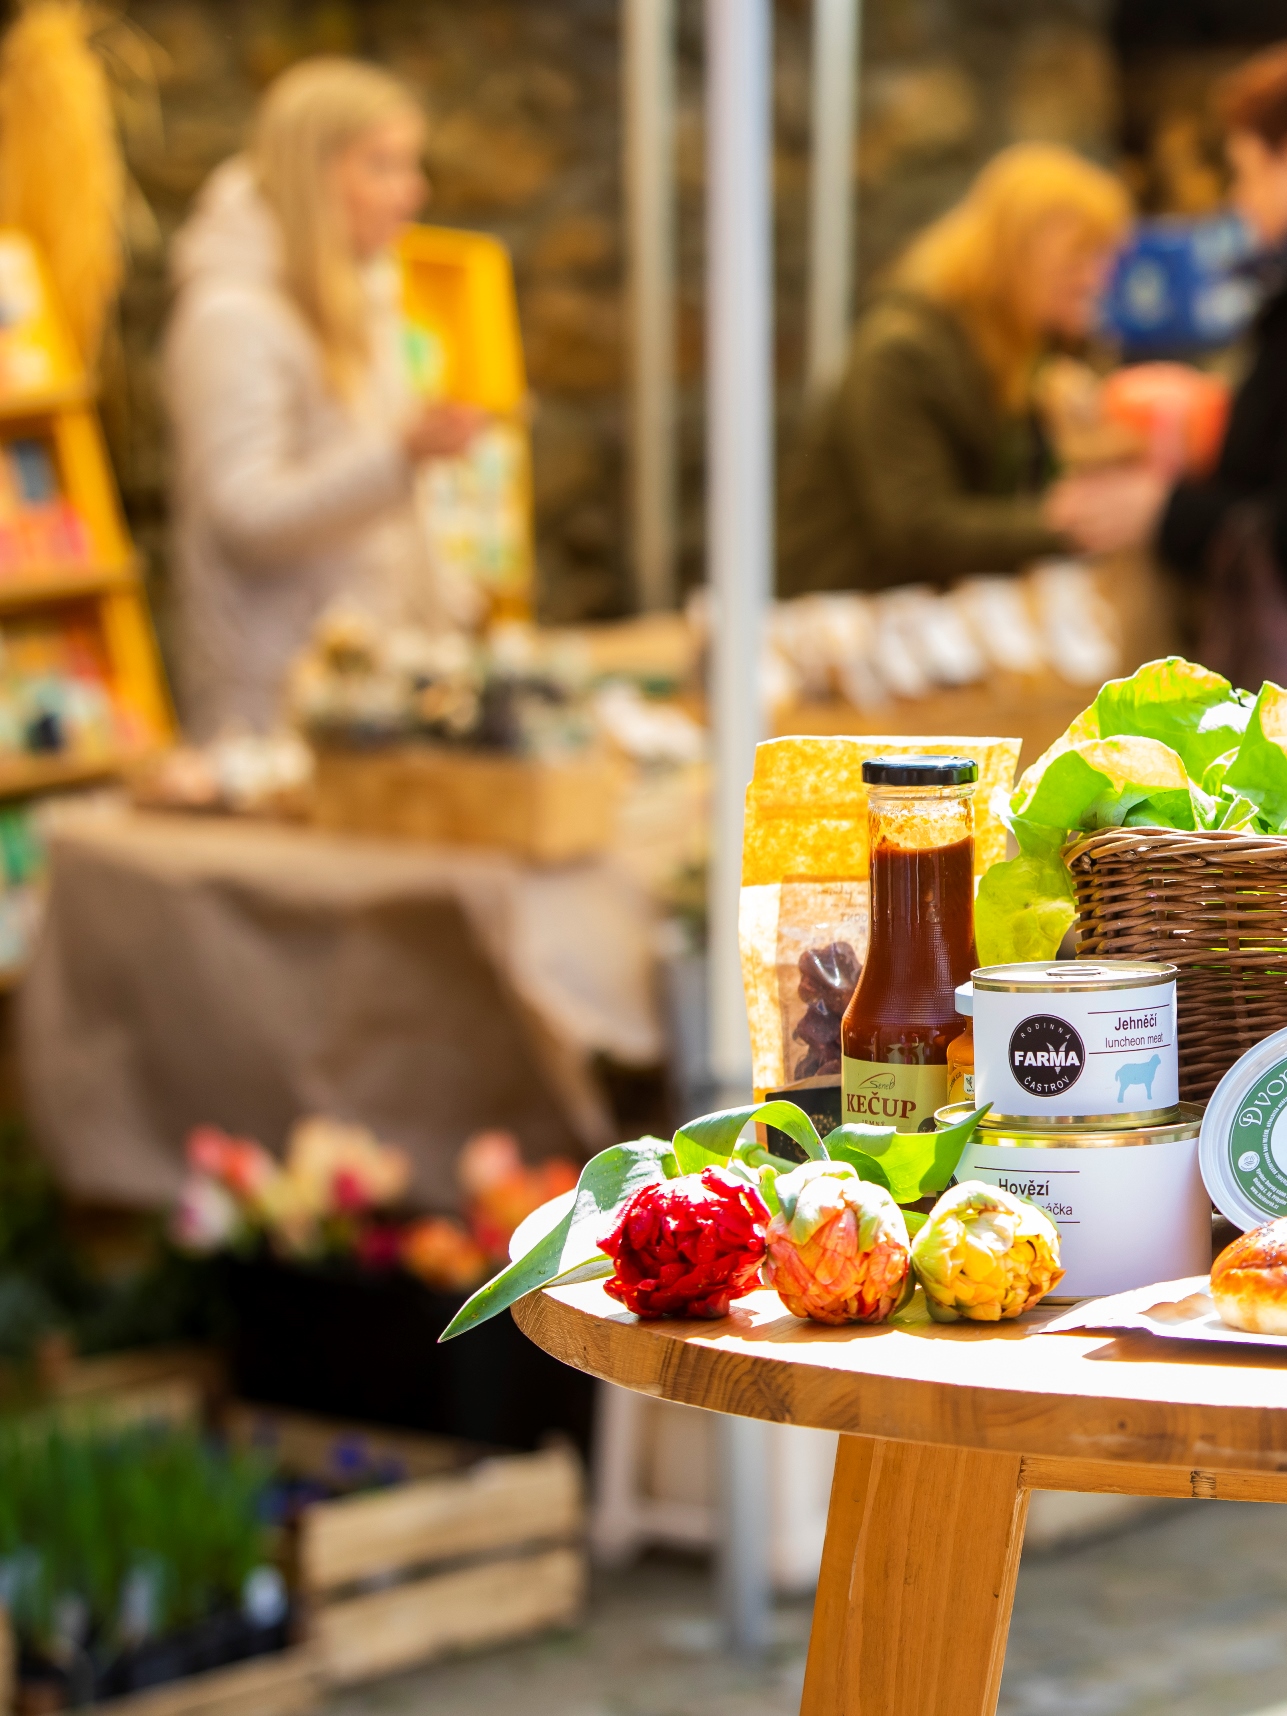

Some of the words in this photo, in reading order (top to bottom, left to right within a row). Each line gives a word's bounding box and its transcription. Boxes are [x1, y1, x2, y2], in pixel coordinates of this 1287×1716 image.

[1114, 1012, 1158, 1031] Jehněčí
[1105, 1036, 1146, 1049] luncheon
[1147, 1032, 1164, 1044] meat
[1014, 1051, 1080, 1067] FARMA
[1024, 1075, 1070, 1093] ČASTROV
[846, 1091, 917, 1119] KEČUP
[999, 1178, 1050, 1196] Hovězí
